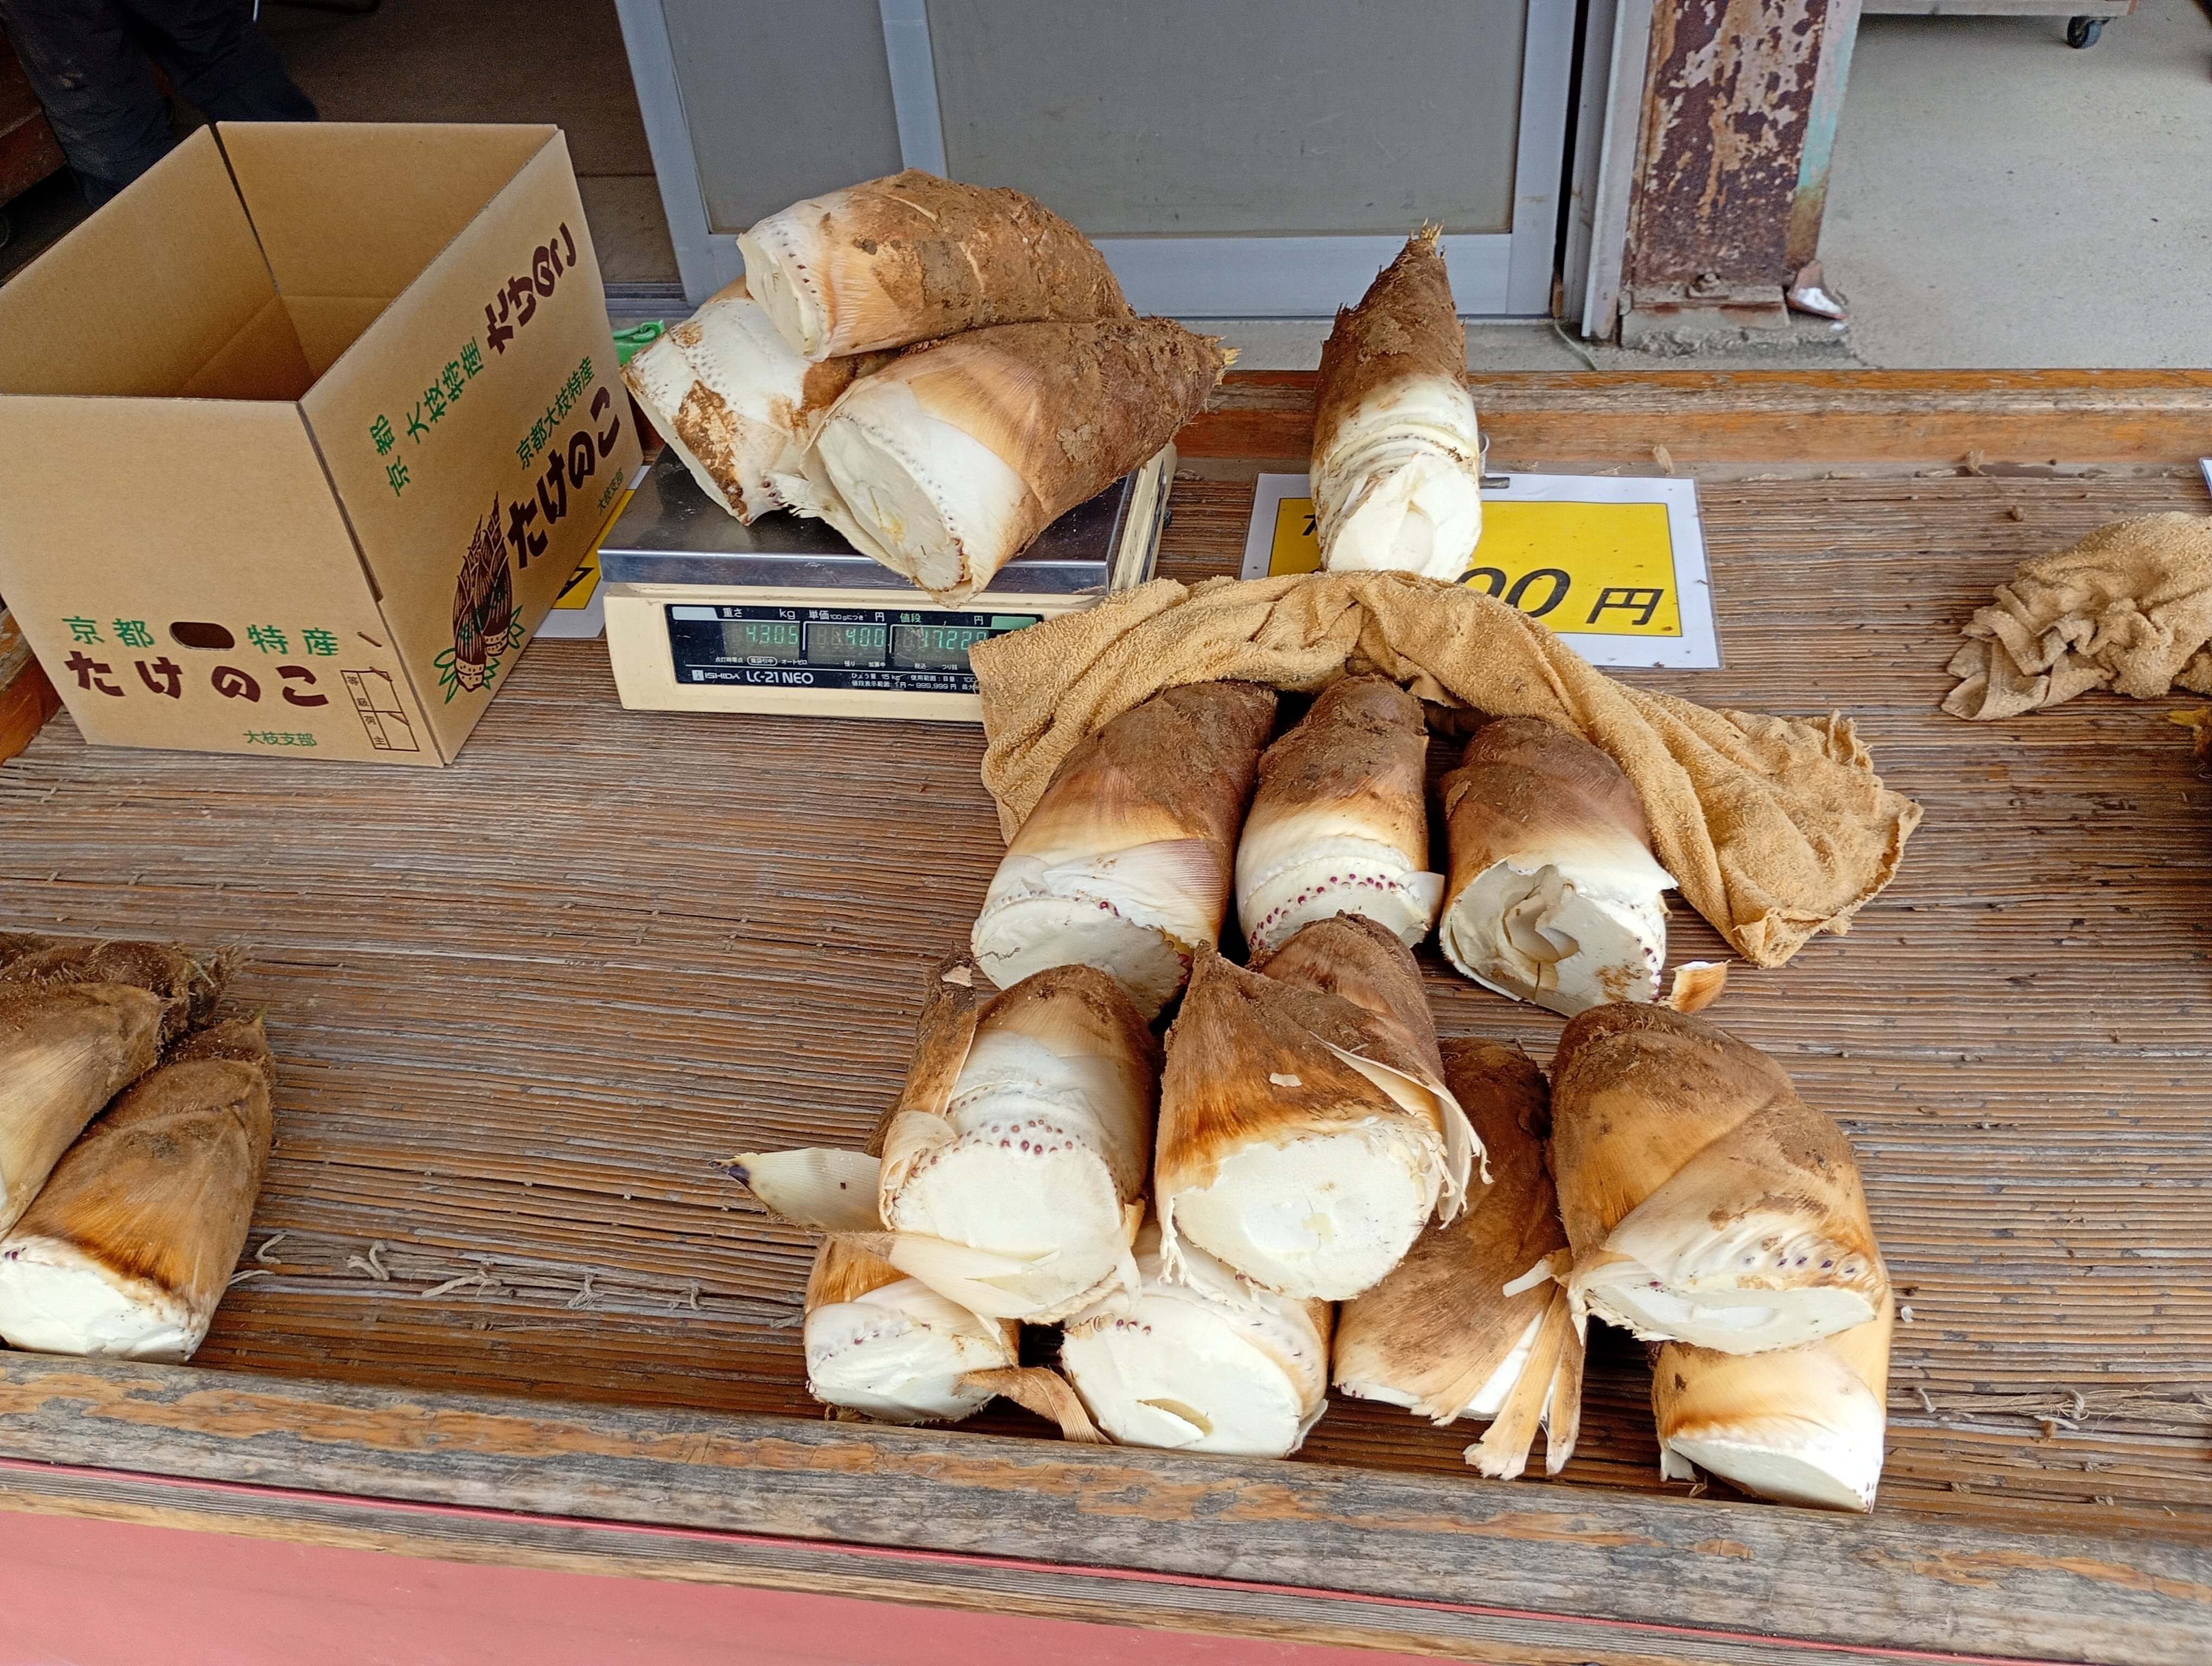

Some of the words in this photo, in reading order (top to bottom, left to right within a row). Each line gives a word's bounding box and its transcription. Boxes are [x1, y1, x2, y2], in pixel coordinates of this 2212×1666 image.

[485, 221, 576, 355] たけのこ
[407, 336, 484, 445] 大枝特産
[516, 356, 594, 470] 京都大枝特産
[370, 414, 410, 497] 京都
[507, 386, 620, 569] たけのこ
[723, 607, 742, 618] 重さ
[779, 608, 796, 619] kg
[874, 612, 885, 622] 円
[900, 612, 922, 623] 値段
[974, 615, 983, 625] 円
[61, 616, 156, 648] 京都
[246, 624, 339, 656] 特産
[746, 625, 799, 644] 4.305
[846, 628, 885, 648] 400
[63, 651, 329, 707] たけのこ
[746, 671, 779, 683] LC-21
[782, 672, 814, 684] NEO
[242, 730, 317, 747] 大枝支部
